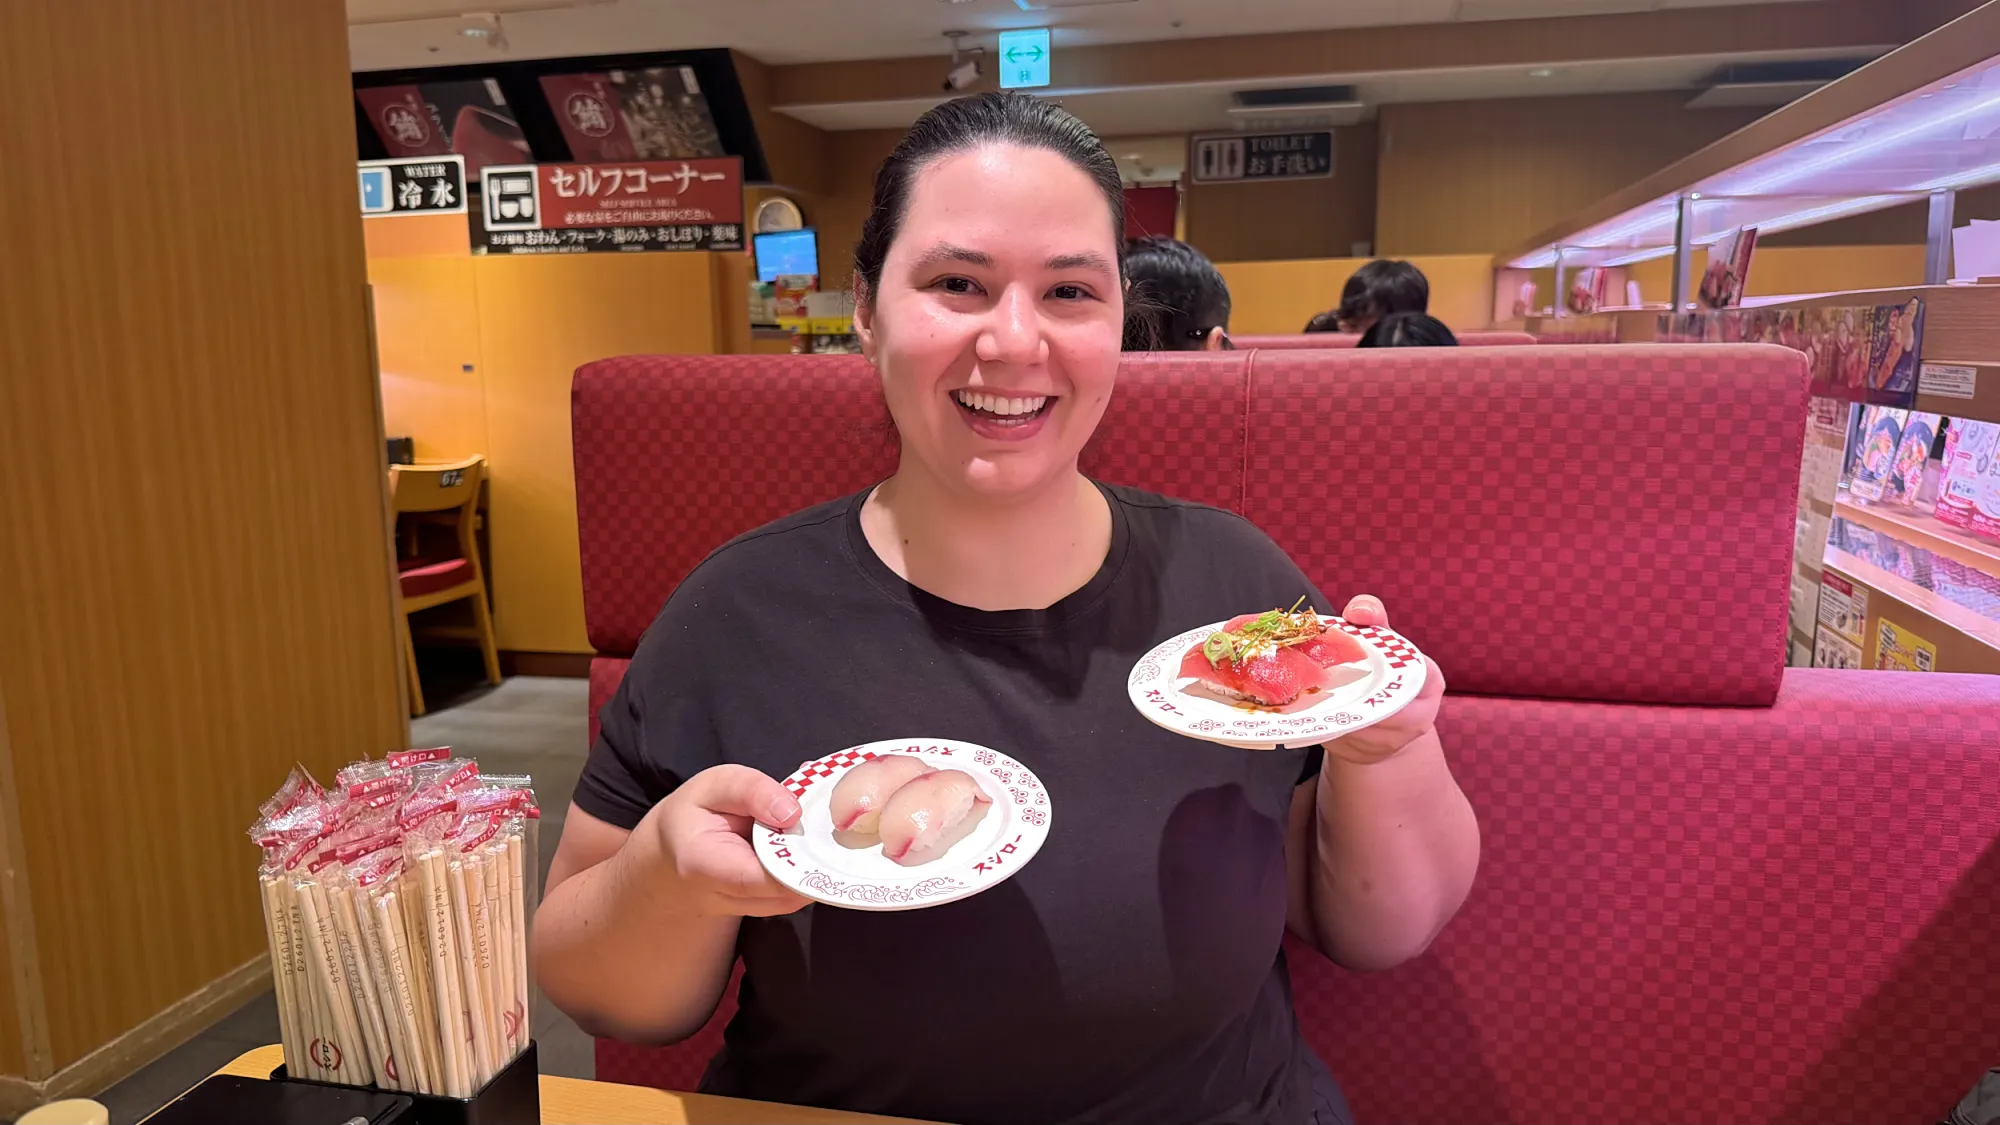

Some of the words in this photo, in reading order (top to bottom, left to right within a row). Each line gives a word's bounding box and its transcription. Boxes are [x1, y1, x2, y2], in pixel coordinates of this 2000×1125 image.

[1251, 136, 1314, 152] TOILET
[403, 163, 446, 179] WATER
[550, 163, 726, 199] セルフコーナー
[398, 178, 456, 209] 冷水
[1143, 689, 1184, 717] スシロー
[1362, 674, 1403, 708] スシロー
[889, 745, 959, 757] スシロー
[972, 834, 1023, 877] スシロー
[322, 1036, 333, 1073] スシロー
